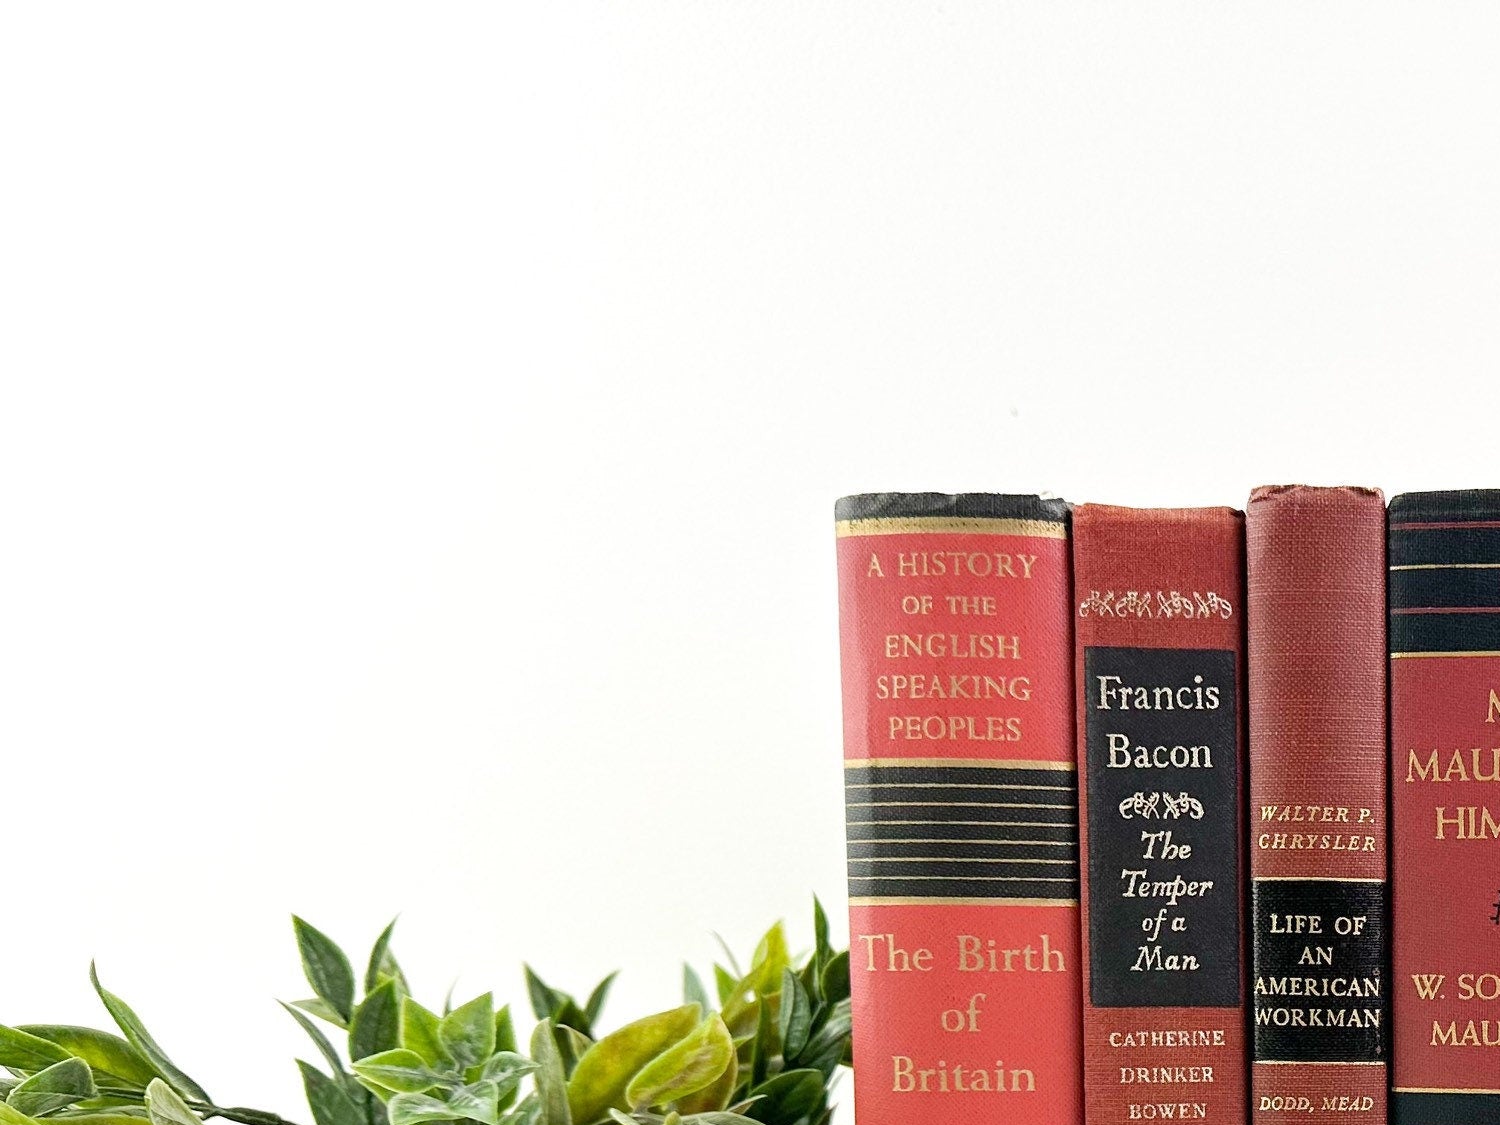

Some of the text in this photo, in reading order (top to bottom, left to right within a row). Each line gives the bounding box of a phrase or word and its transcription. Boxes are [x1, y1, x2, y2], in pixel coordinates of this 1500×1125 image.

[867, 551, 1038, 578] A HISTORY
[902, 596, 997, 616] OF THE
[885, 634, 1021, 660] ENGLISH
[876, 675, 1031, 701] SPEAKING
[1096, 675, 1221, 711] Francis
[889, 715, 1022, 742] PEOPLES
[1106, 733, 1213, 769] Bacon
[1260, 806, 1375, 824] WALTER P.
[1141, 830, 1192, 860] The
[1259, 833, 1376, 852] CHRYSLER
[1121, 869, 1213, 906] Temper
[1142, 909, 1187, 942] of a
[1270, 914, 1366, 936] LIFE OF
[859, 934, 1067, 973] The Birth
[1130, 947, 1200, 972] Man
[1298, 947, 1333, 965] AN
[1254, 977, 1380, 998] AMERICAN
[1411, 973, 1445, 1001] W.
[941, 993, 987, 1033] of
[1255, 1008, 1381, 1028] WORKMAN
[1109, 1030, 1226, 1048] CATHERINE
[892, 1056, 1037, 1093] Britain
[1120, 1066, 1214, 1084] DRINKER
[1129, 1102, 1208, 1120] BOWEN
[1259, 1096, 1374, 1113] DODD, MEAD
